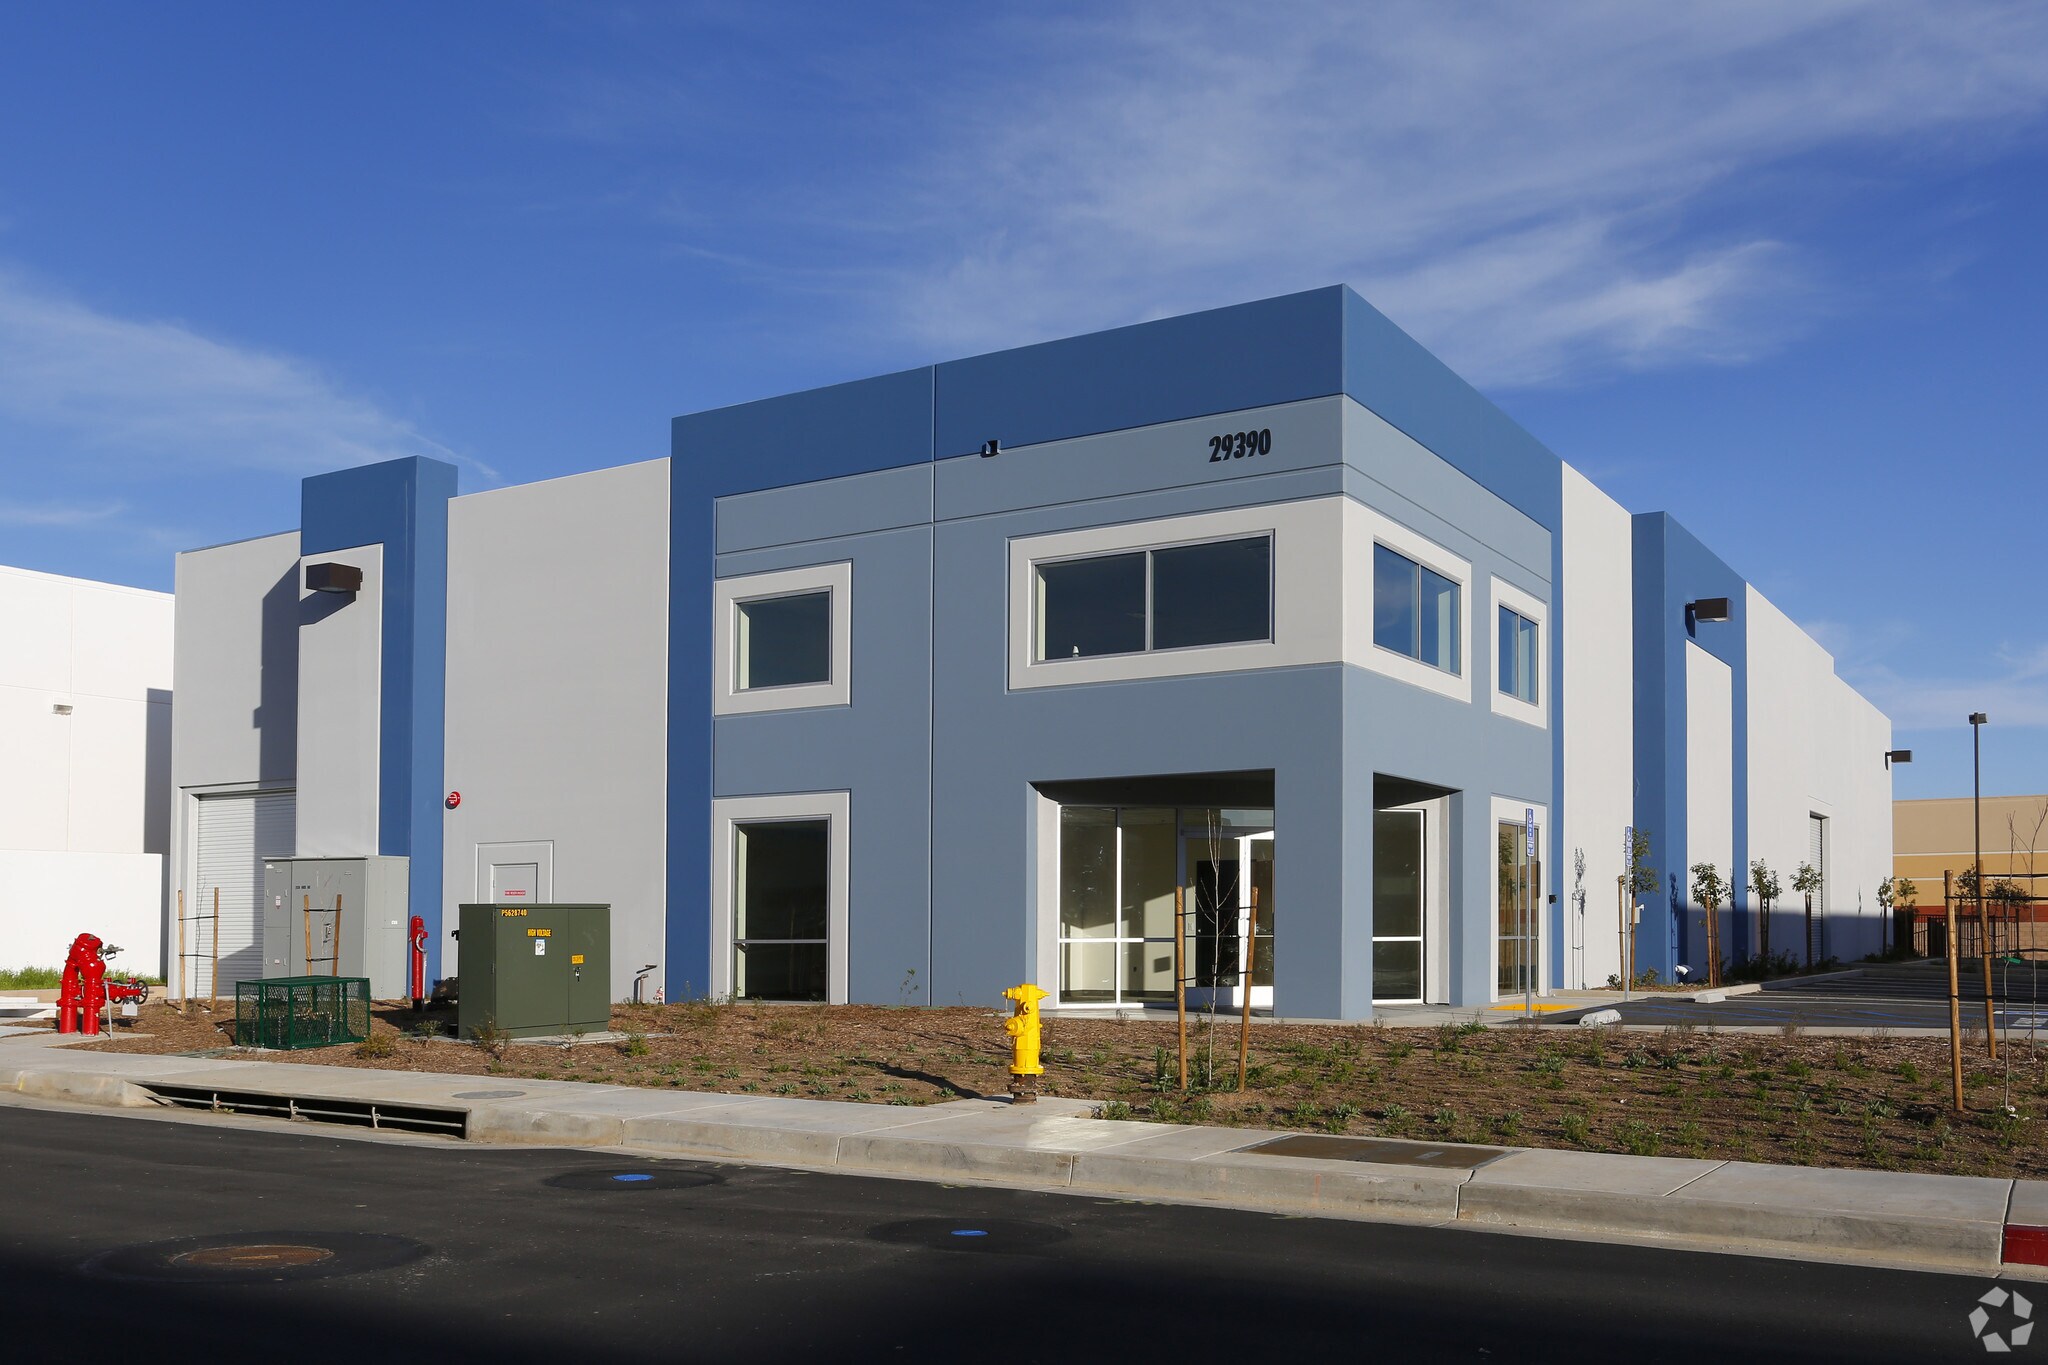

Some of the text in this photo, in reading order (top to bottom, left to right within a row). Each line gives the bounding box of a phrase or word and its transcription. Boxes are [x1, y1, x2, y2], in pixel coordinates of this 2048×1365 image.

[1209, 428, 1271, 463] 29390
[527, 928, 551, 937] HIGH VOLTAGE
